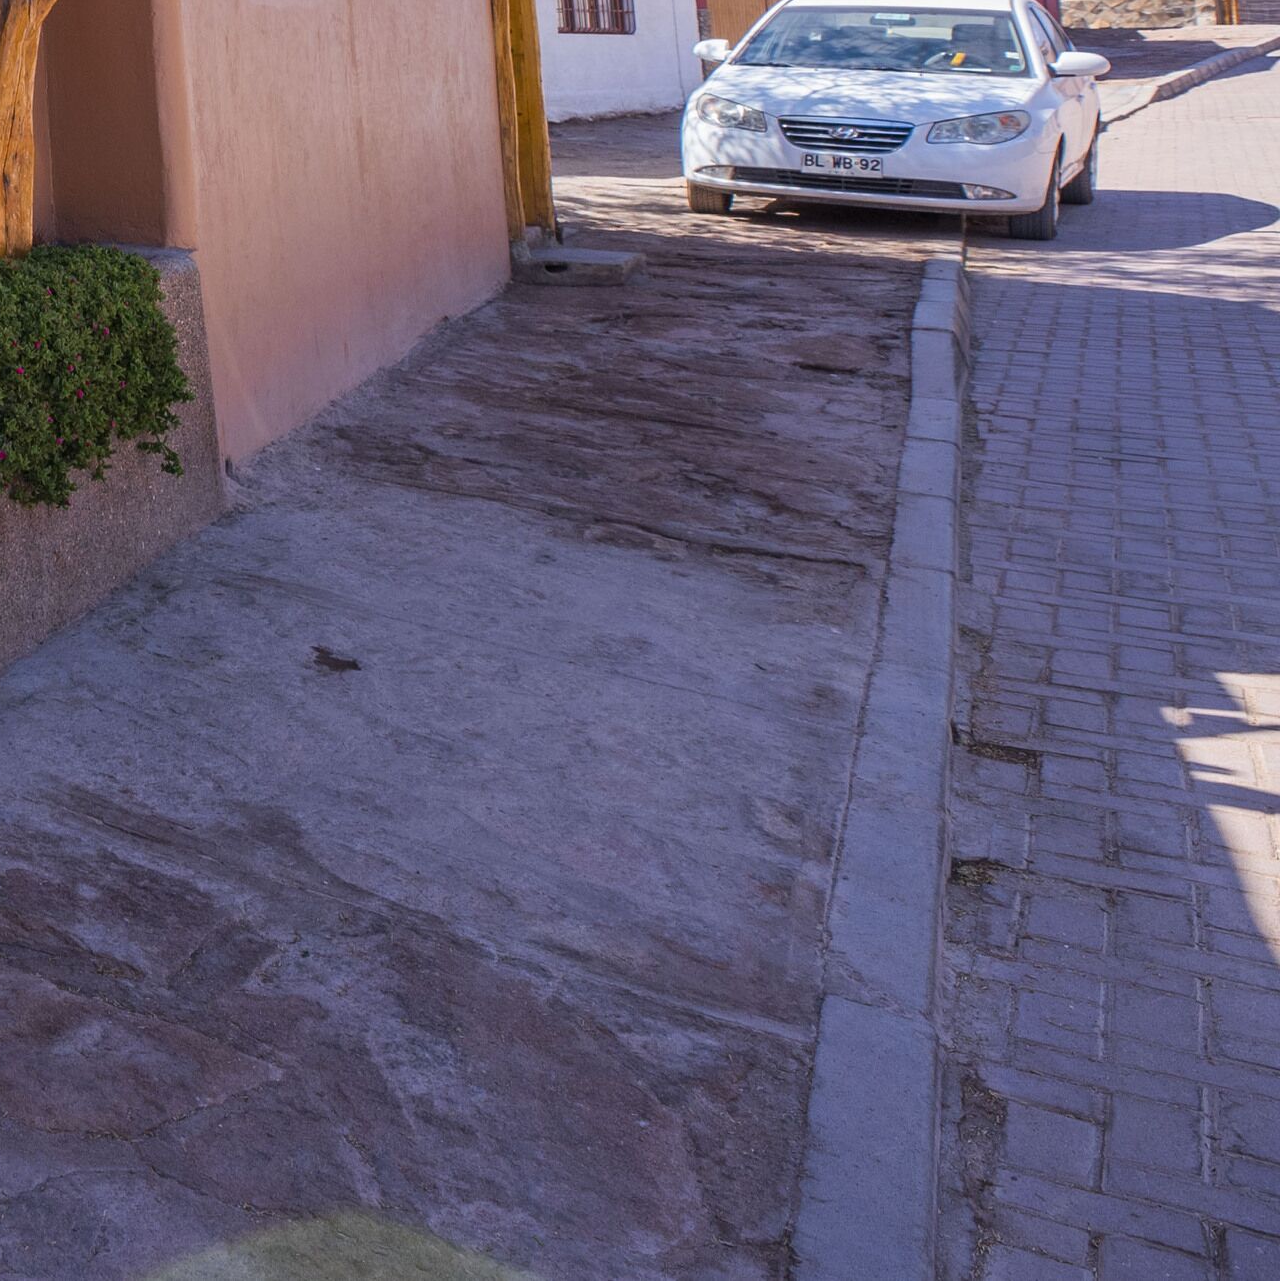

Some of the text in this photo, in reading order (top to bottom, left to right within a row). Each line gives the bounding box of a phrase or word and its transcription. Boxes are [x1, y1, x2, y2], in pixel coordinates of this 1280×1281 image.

[804, 154, 881, 171] BL WB 92
